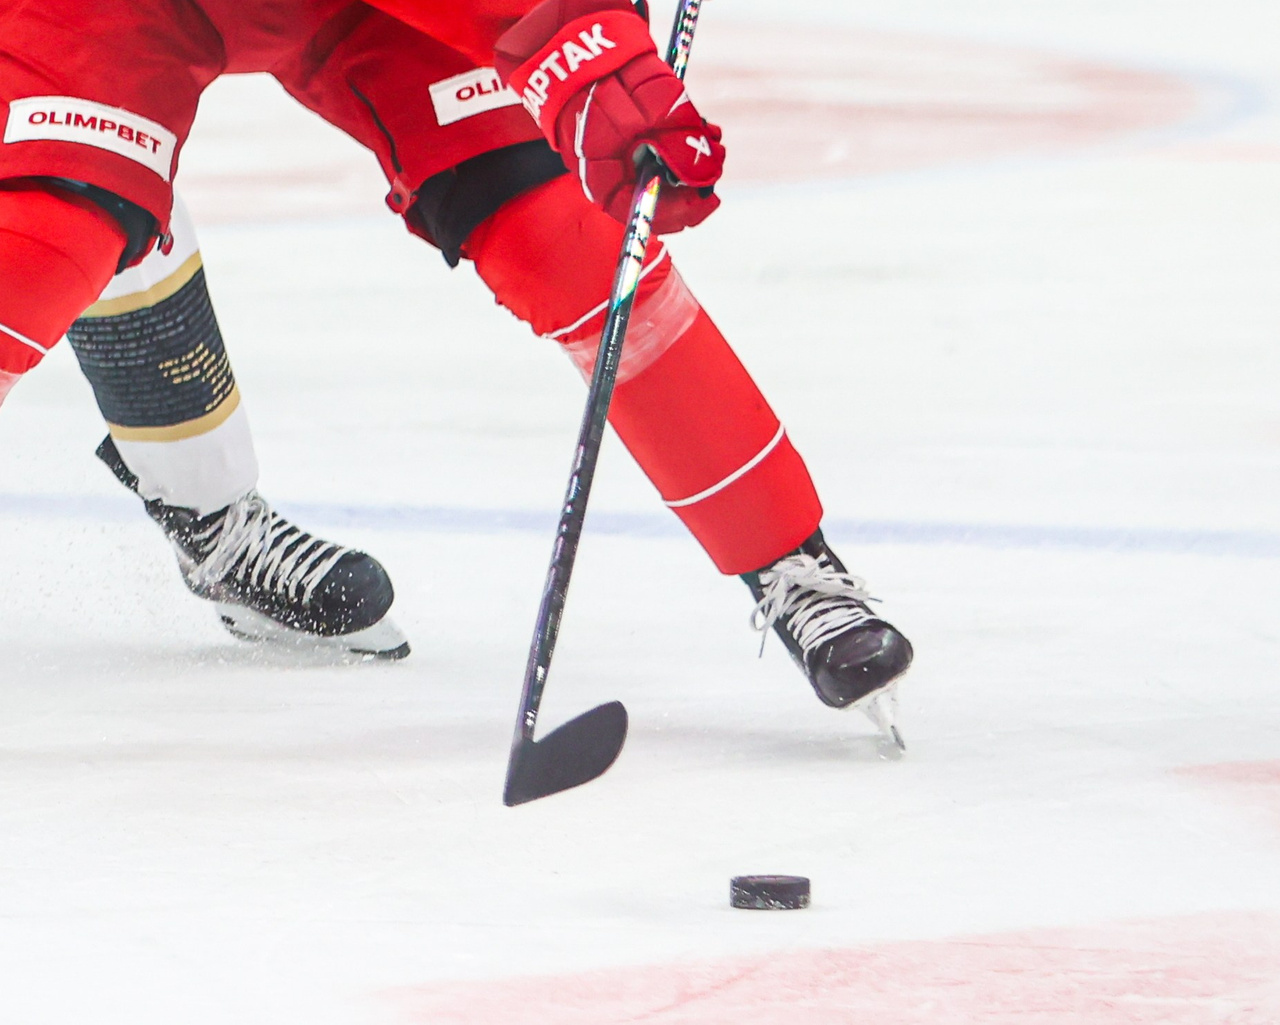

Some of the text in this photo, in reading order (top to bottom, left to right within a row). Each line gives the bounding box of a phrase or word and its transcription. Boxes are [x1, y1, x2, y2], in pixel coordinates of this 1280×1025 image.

[455, 78, 507, 101] OLI
[522, 22, 617, 129] АРТАК
[28, 111, 162, 155] OLIMPBET
